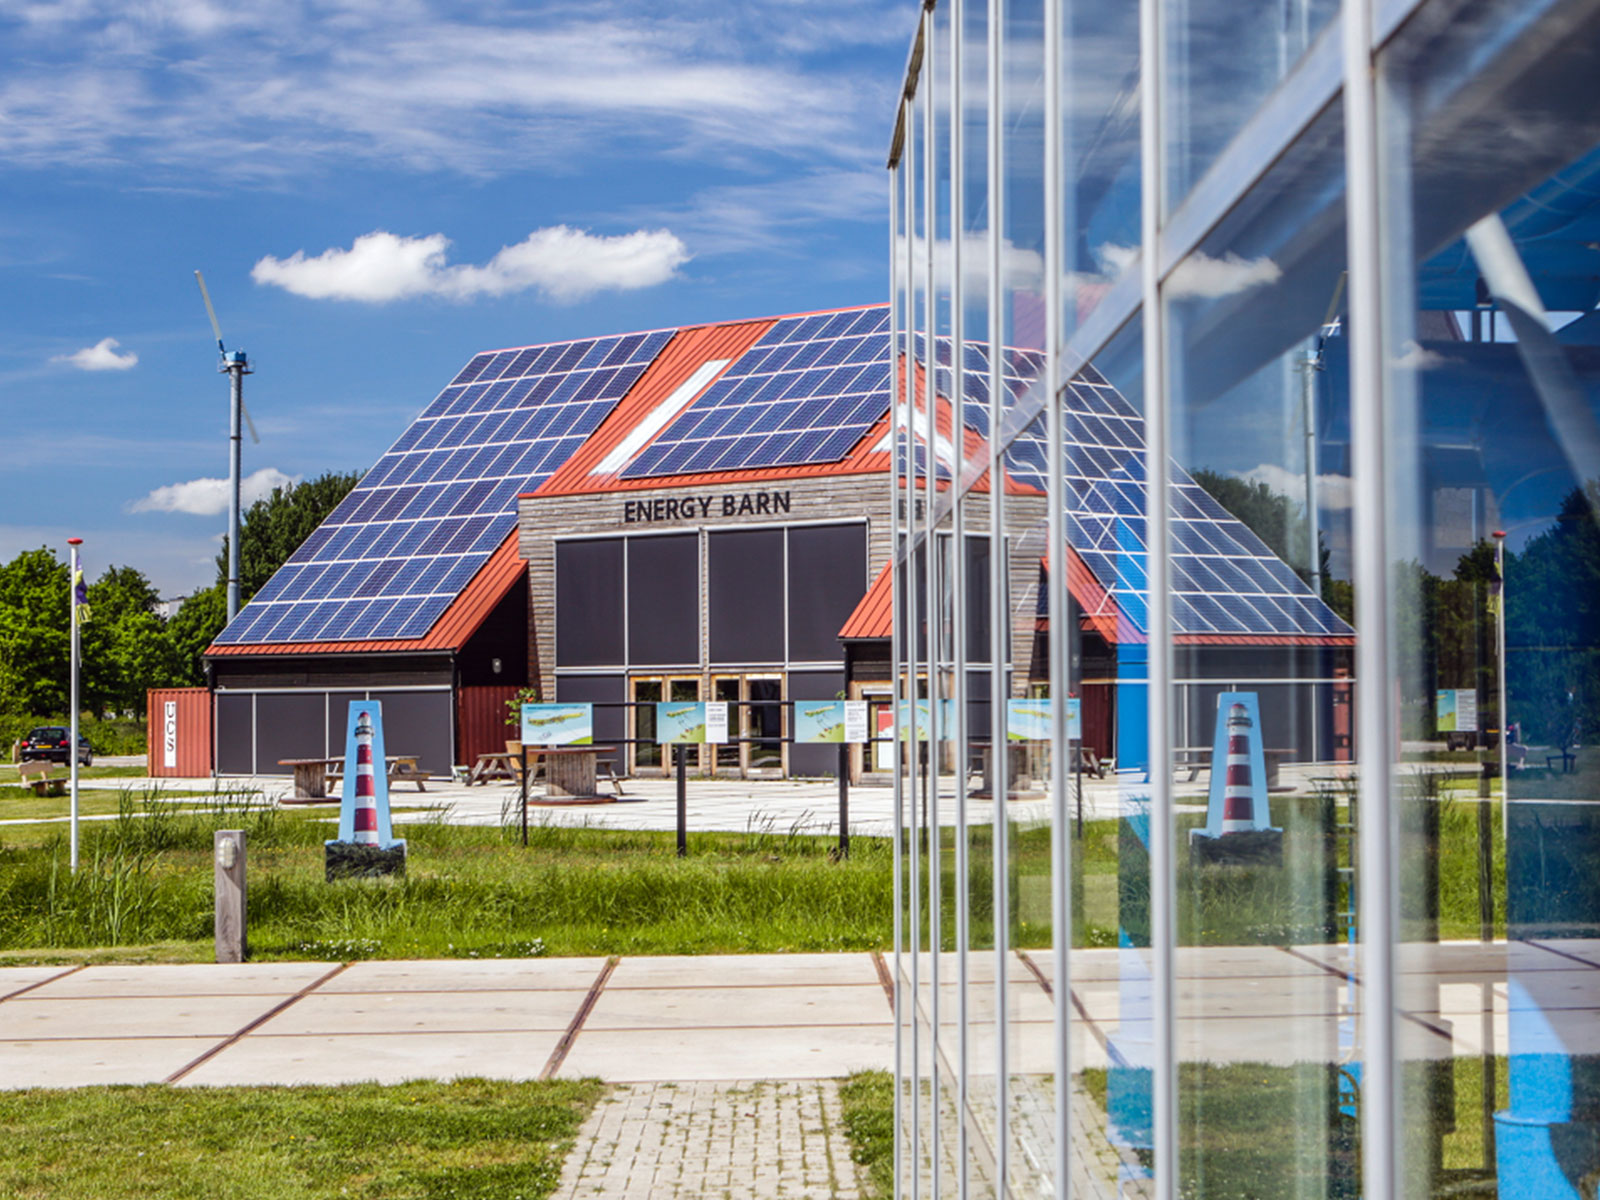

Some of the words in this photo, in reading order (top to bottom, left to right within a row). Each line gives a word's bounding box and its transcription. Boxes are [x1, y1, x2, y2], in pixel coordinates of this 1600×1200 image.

[624, 495, 714, 523] ENERGY
[722, 490, 791, 516] BARN
[166, 703, 175, 752] UCS
